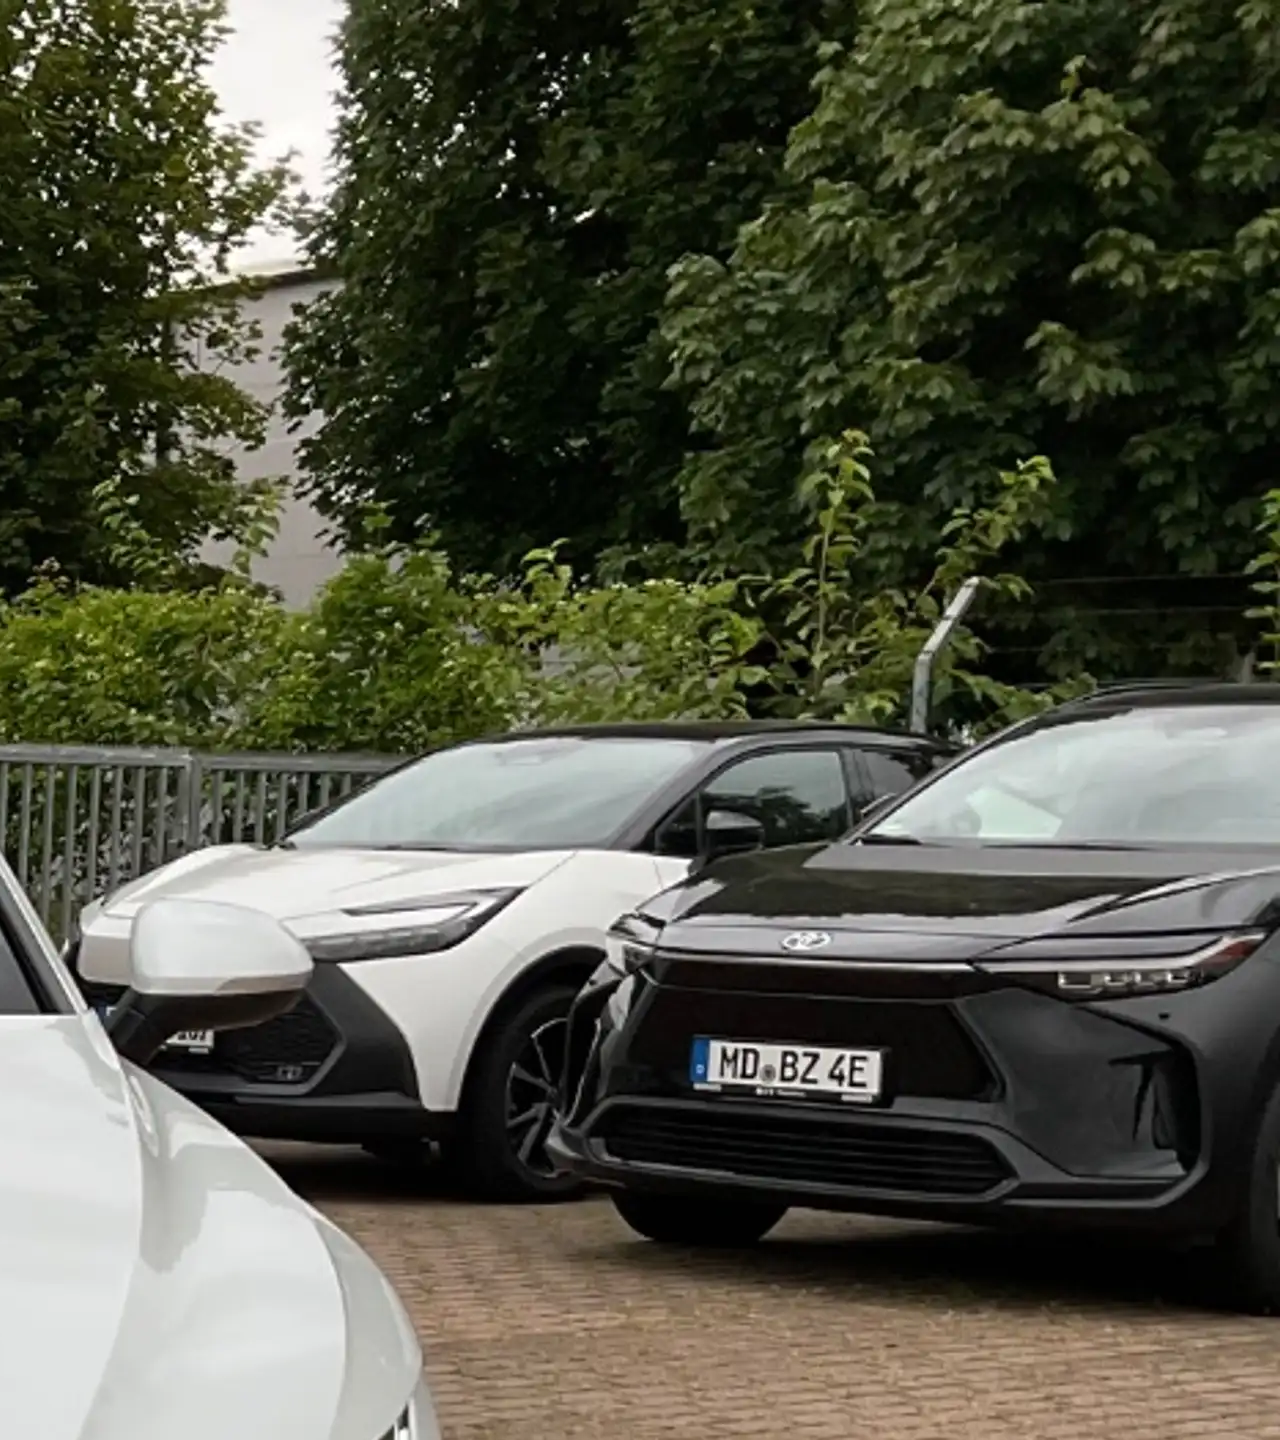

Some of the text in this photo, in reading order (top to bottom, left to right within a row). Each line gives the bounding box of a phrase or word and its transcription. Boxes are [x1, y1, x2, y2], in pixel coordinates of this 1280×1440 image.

[719, 1046, 868, 1088] MD BZ 4E
